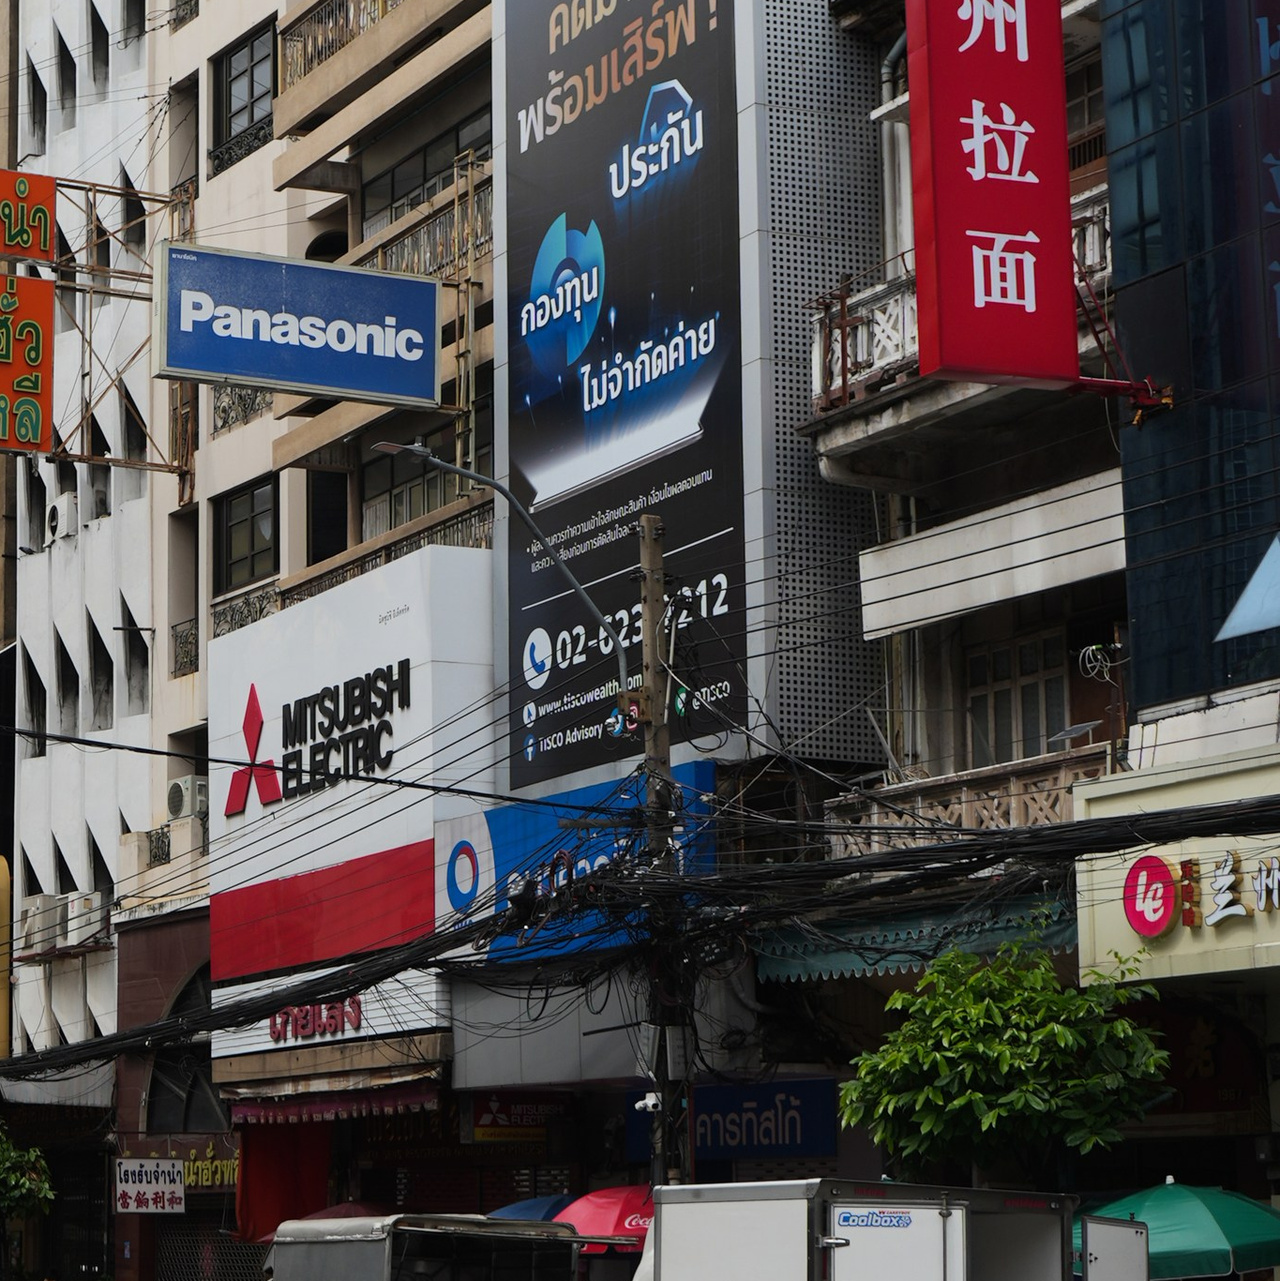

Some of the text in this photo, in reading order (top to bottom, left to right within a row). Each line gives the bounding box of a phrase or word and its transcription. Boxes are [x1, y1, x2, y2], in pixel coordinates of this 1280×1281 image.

[609, 108, 704, 199] ประกัน
[180, 289, 425, 363] Panasonic
[521, 267, 599, 337] กองทุน
[581, 318, 717, 413] ไม่จำกัดค่าย
[282, 657, 412, 752] MITSUBISHI
[538, 673, 643, 718] www.tiscowealth.om
[282, 719, 395, 800] ELECTRIC
[538, 723, 604, 753] TISCO Advisory
[695, 1092, 802, 1148] คารทิสโก้
[117, 1161, 183, 1184] โรงรับจำนำ
[838, 1212, 900, 1227] Coolbox
